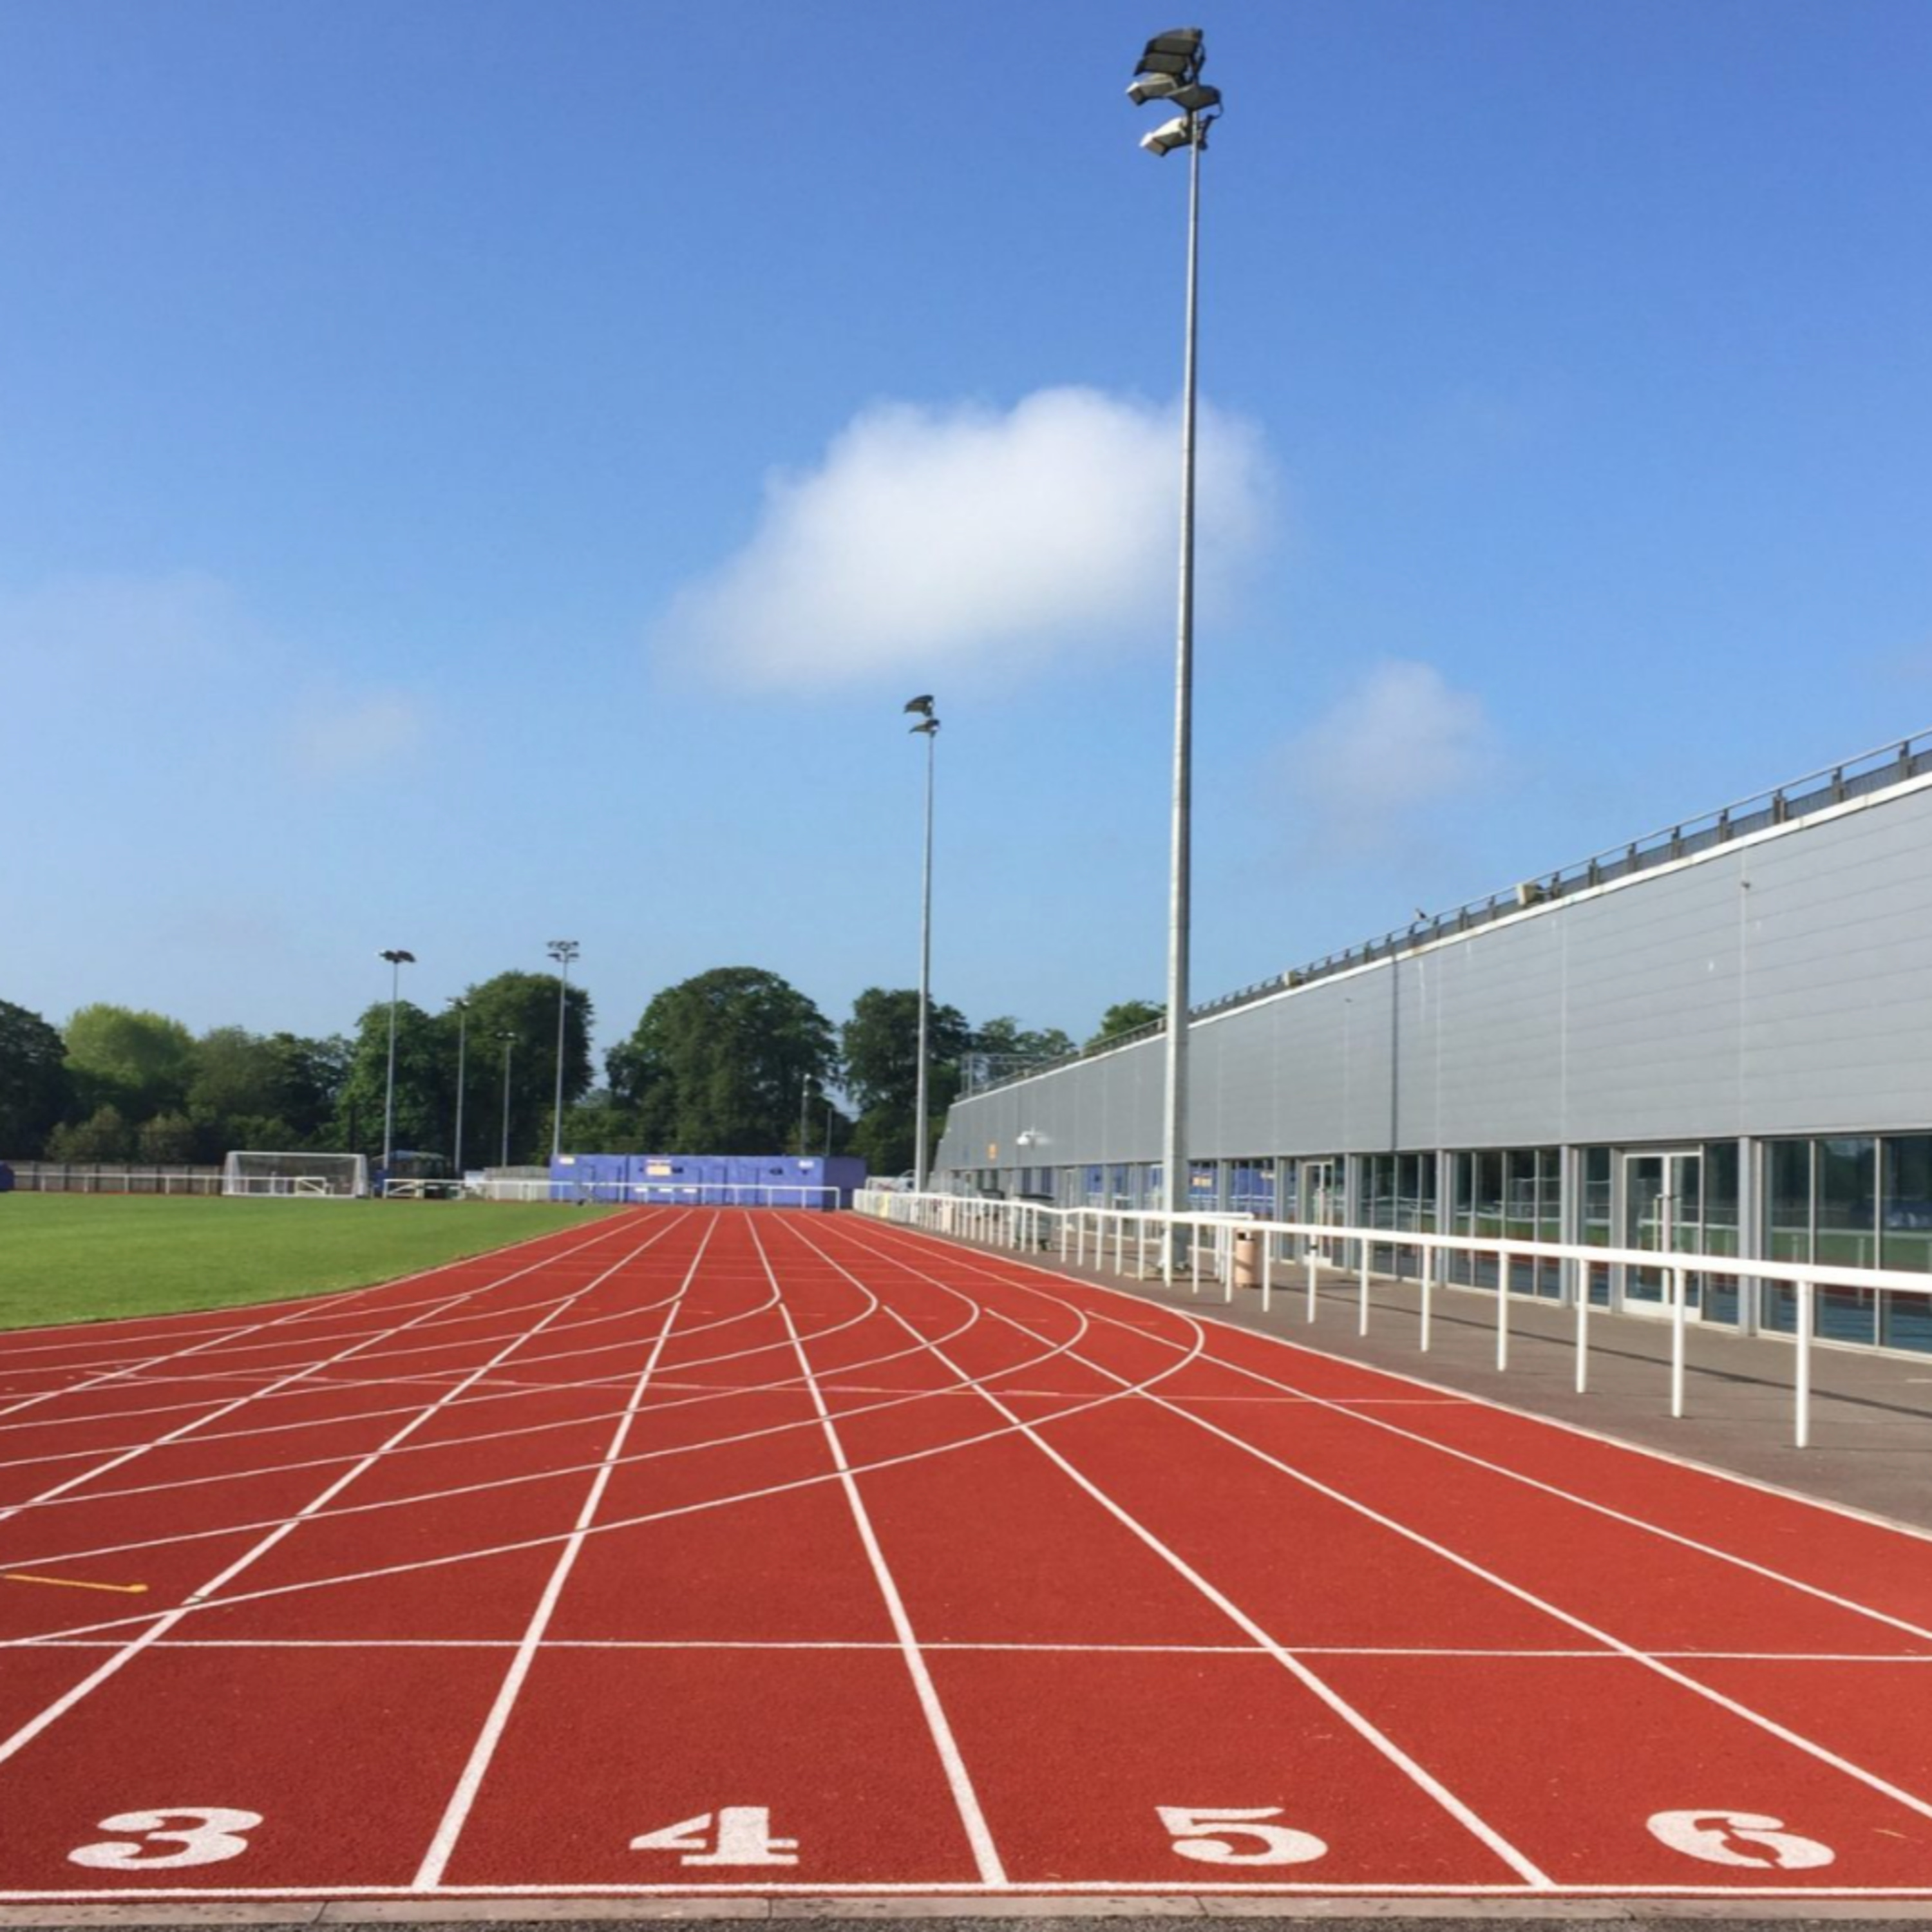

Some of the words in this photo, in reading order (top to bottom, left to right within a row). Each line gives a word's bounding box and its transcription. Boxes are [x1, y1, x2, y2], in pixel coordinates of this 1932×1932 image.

[67, 1806, 263, 1870] 3
[629, 1806, 799, 1866] 4
[1155, 1804, 1327, 1865] 5
[1646, 1809, 1835, 1869] 6
